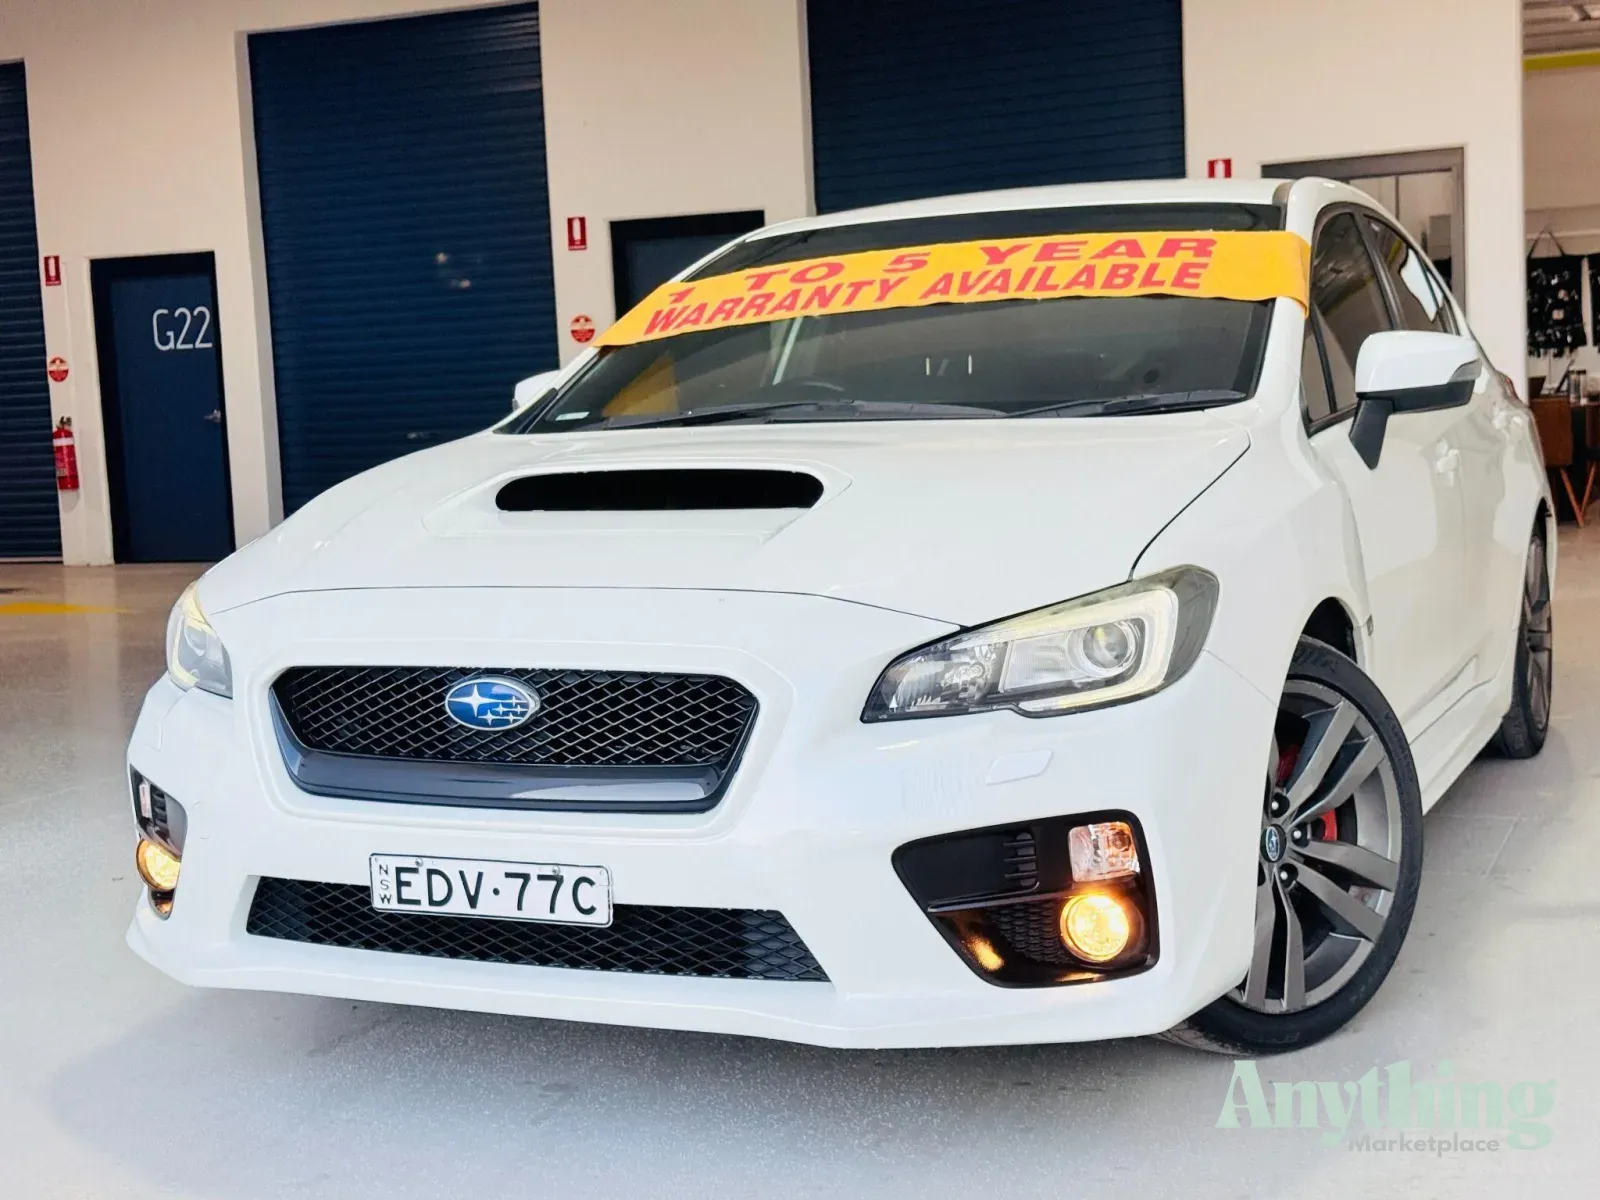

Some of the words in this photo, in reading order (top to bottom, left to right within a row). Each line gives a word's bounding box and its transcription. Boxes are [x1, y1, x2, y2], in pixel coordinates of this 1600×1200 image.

[643, 276, 909, 335] WARRANTY
[919, 262, 1211, 299] AVAILABLE
[667, 287, 696, 305] 1
[744, 262, 845, 292] TO
[882, 251, 932, 273] 5
[979, 238, 1218, 266] YEAR
[152, 305, 213, 351] G22
[378, 864, 392, 905] NSW
